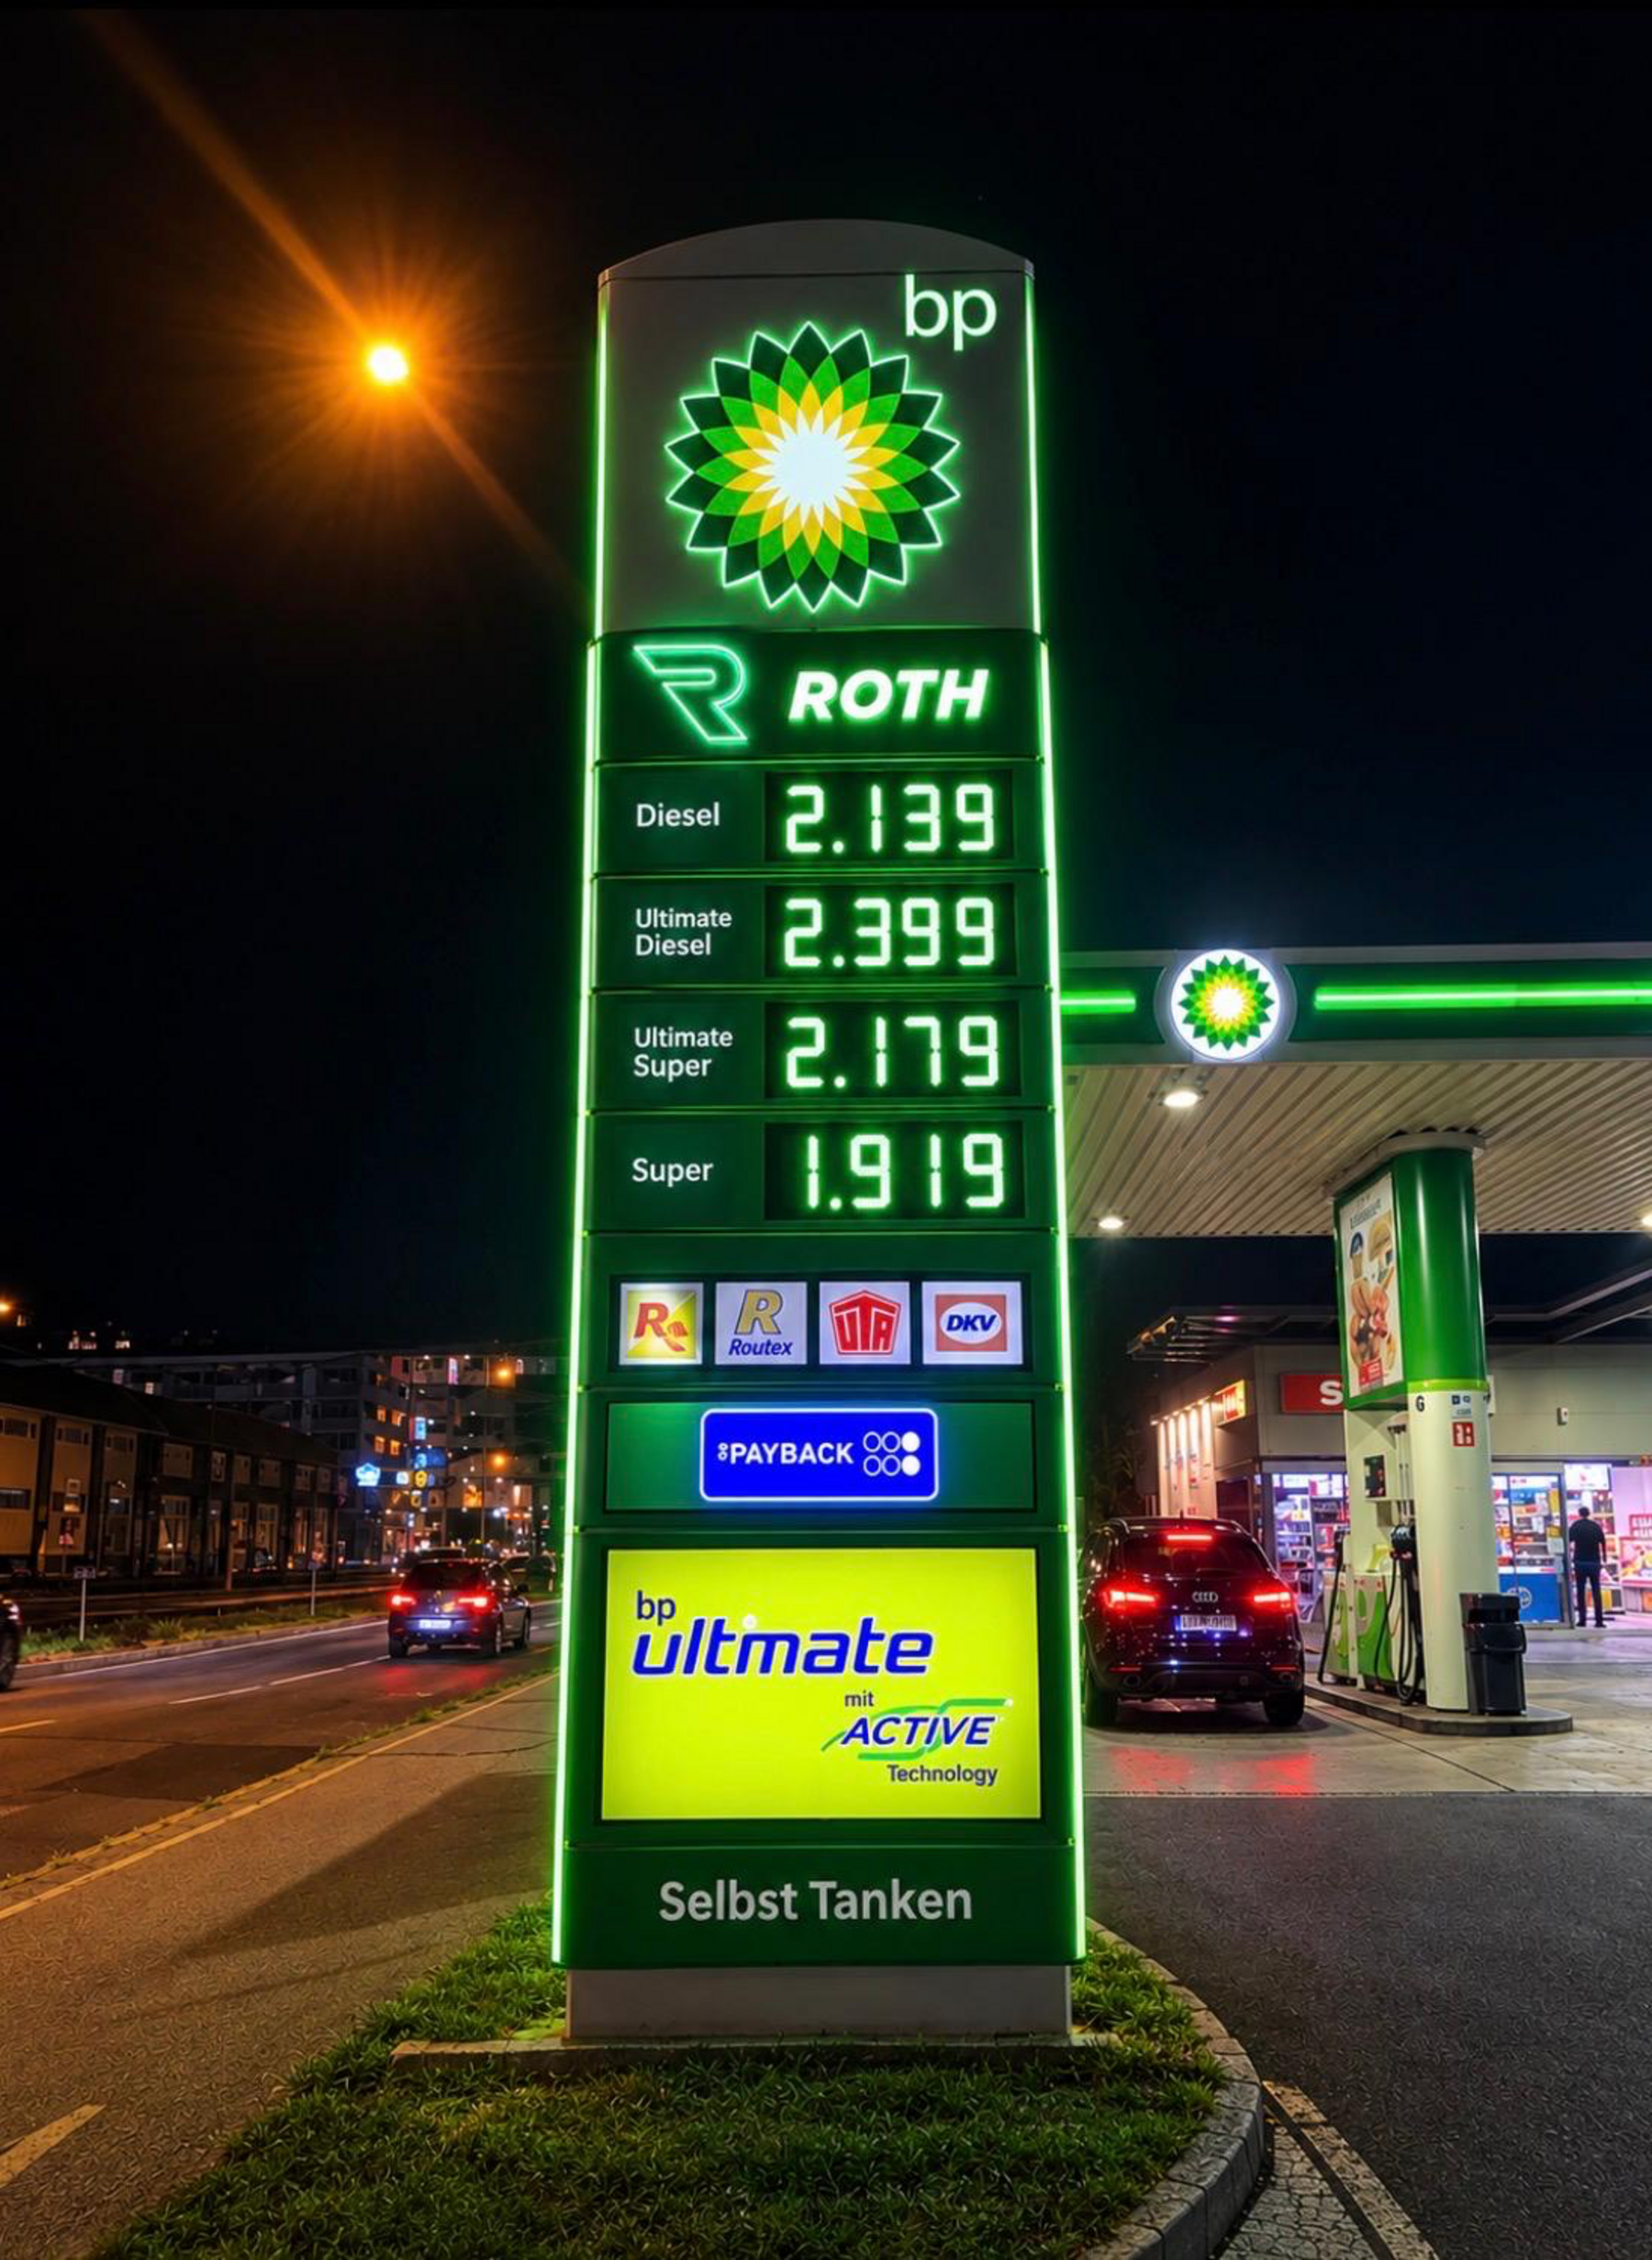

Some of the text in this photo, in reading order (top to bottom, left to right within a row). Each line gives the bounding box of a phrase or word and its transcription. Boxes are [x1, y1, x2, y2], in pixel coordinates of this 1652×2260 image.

[904, 274, 998, 351] bp
[788, 668, 989, 722] ROTH
[636, 801, 720, 827] Diesel
[786, 783, 994, 854] 2.139
[635, 908, 732, 929] Ultimate
[784, 897, 994, 968] 2.399
[635, 932, 711, 957] Diesel
[634, 1026, 733, 1048] Ultimate
[786, 1015, 999, 1088] 2.179
[633, 1053, 712, 1082] Super
[632, 1158, 714, 1188] Super
[807, 1133, 1004, 1210] 1.919
[734, 1289, 783, 1335] R
[831, 1292, 900, 1354] UTA
[946, 1314, 997, 1332] DKV
[728, 1337, 793, 1357] Routex
[730, 1442, 854, 1465] PAYBACK
[637, 1590, 676, 1626] bp
[844, 1690, 874, 1707] mit
[840, 1717, 996, 1745] ACTIVE
[887, 1763, 999, 1787] Technology
[659, 1878, 973, 1921] Selbst Tanken
